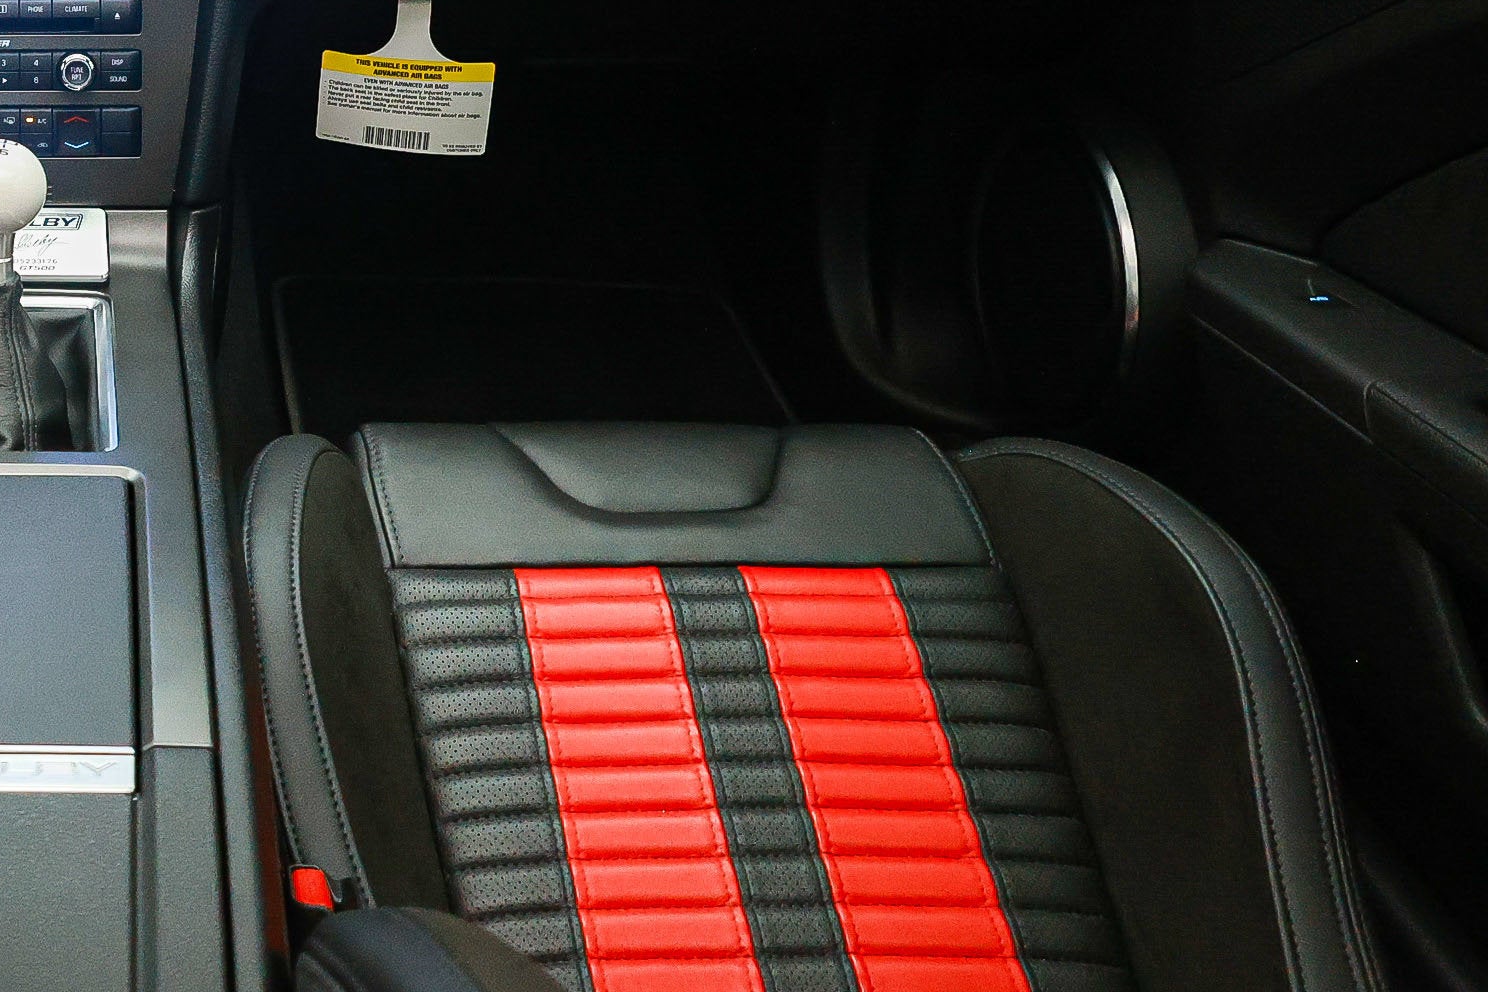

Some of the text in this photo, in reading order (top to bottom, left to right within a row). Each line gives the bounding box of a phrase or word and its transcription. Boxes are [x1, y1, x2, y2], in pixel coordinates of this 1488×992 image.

[27, 5, 44, 13] PHONE
[64, 5, 88, 13] CLIMATE
[356, 58, 371, 66] THIS
[372, 60, 400, 69] VEHICLE
[410, 64, 444, 72] EQUIPPED
[373, 69, 409, 78] ADVANCED
[328, 79, 353, 87] Children
[394, 80, 423, 89] ADVANCED
